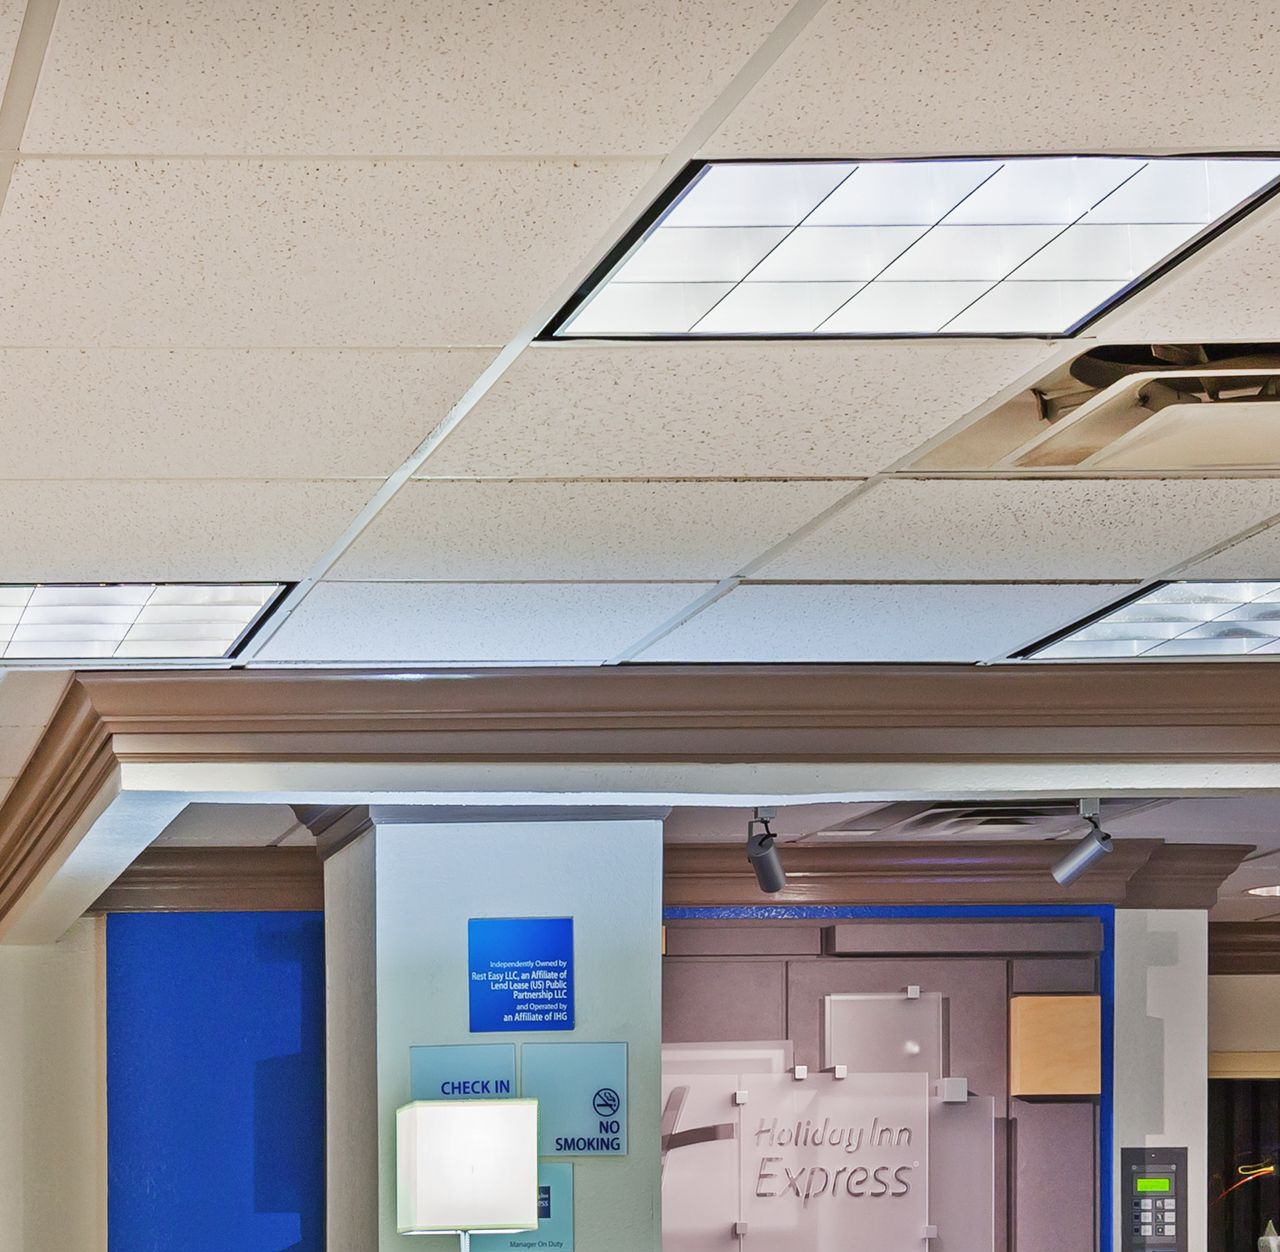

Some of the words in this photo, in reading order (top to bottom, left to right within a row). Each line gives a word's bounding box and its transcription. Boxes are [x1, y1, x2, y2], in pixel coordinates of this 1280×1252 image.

[489, 960, 534, 968] Independently
[558, 959, 567, 968] by
[471, 972, 487, 981] Rest
[488, 971, 504, 982] Easy
[505, 971, 520, 981] LLC,
[531, 970, 558, 979] Affiliate
[559, 969, 568, 979] of
[490, 981, 508, 990] Lend
[509, 981, 529, 990] Lease
[530, 980, 545, 990] (US)
[545, 980, 567, 989] Public
[513, 990, 553, 1000] Partnership
[554, 989, 567, 999] LLC
[529, 1003, 558, 1011] Operated
[559, 1002, 568, 1011] by
[514, 1012, 543, 1021] Affiliate
[544, 1011, 553, 1021] of
[553, 1011, 568, 1021] IHG
[440, 1080, 491, 1095] CHECK
[495, 1079, 510, 1094] IN
[599, 1120, 620, 1134] NO
[754, 1117, 864, 1154] Holiday
[870, 1117, 913, 1147] Inn
[555, 1137, 621, 1151] SMOKING
[755, 1157, 913, 1209] Express
[509, 1241, 537, 1249] Manager
[548, 1240, 563, 1248] Duty
